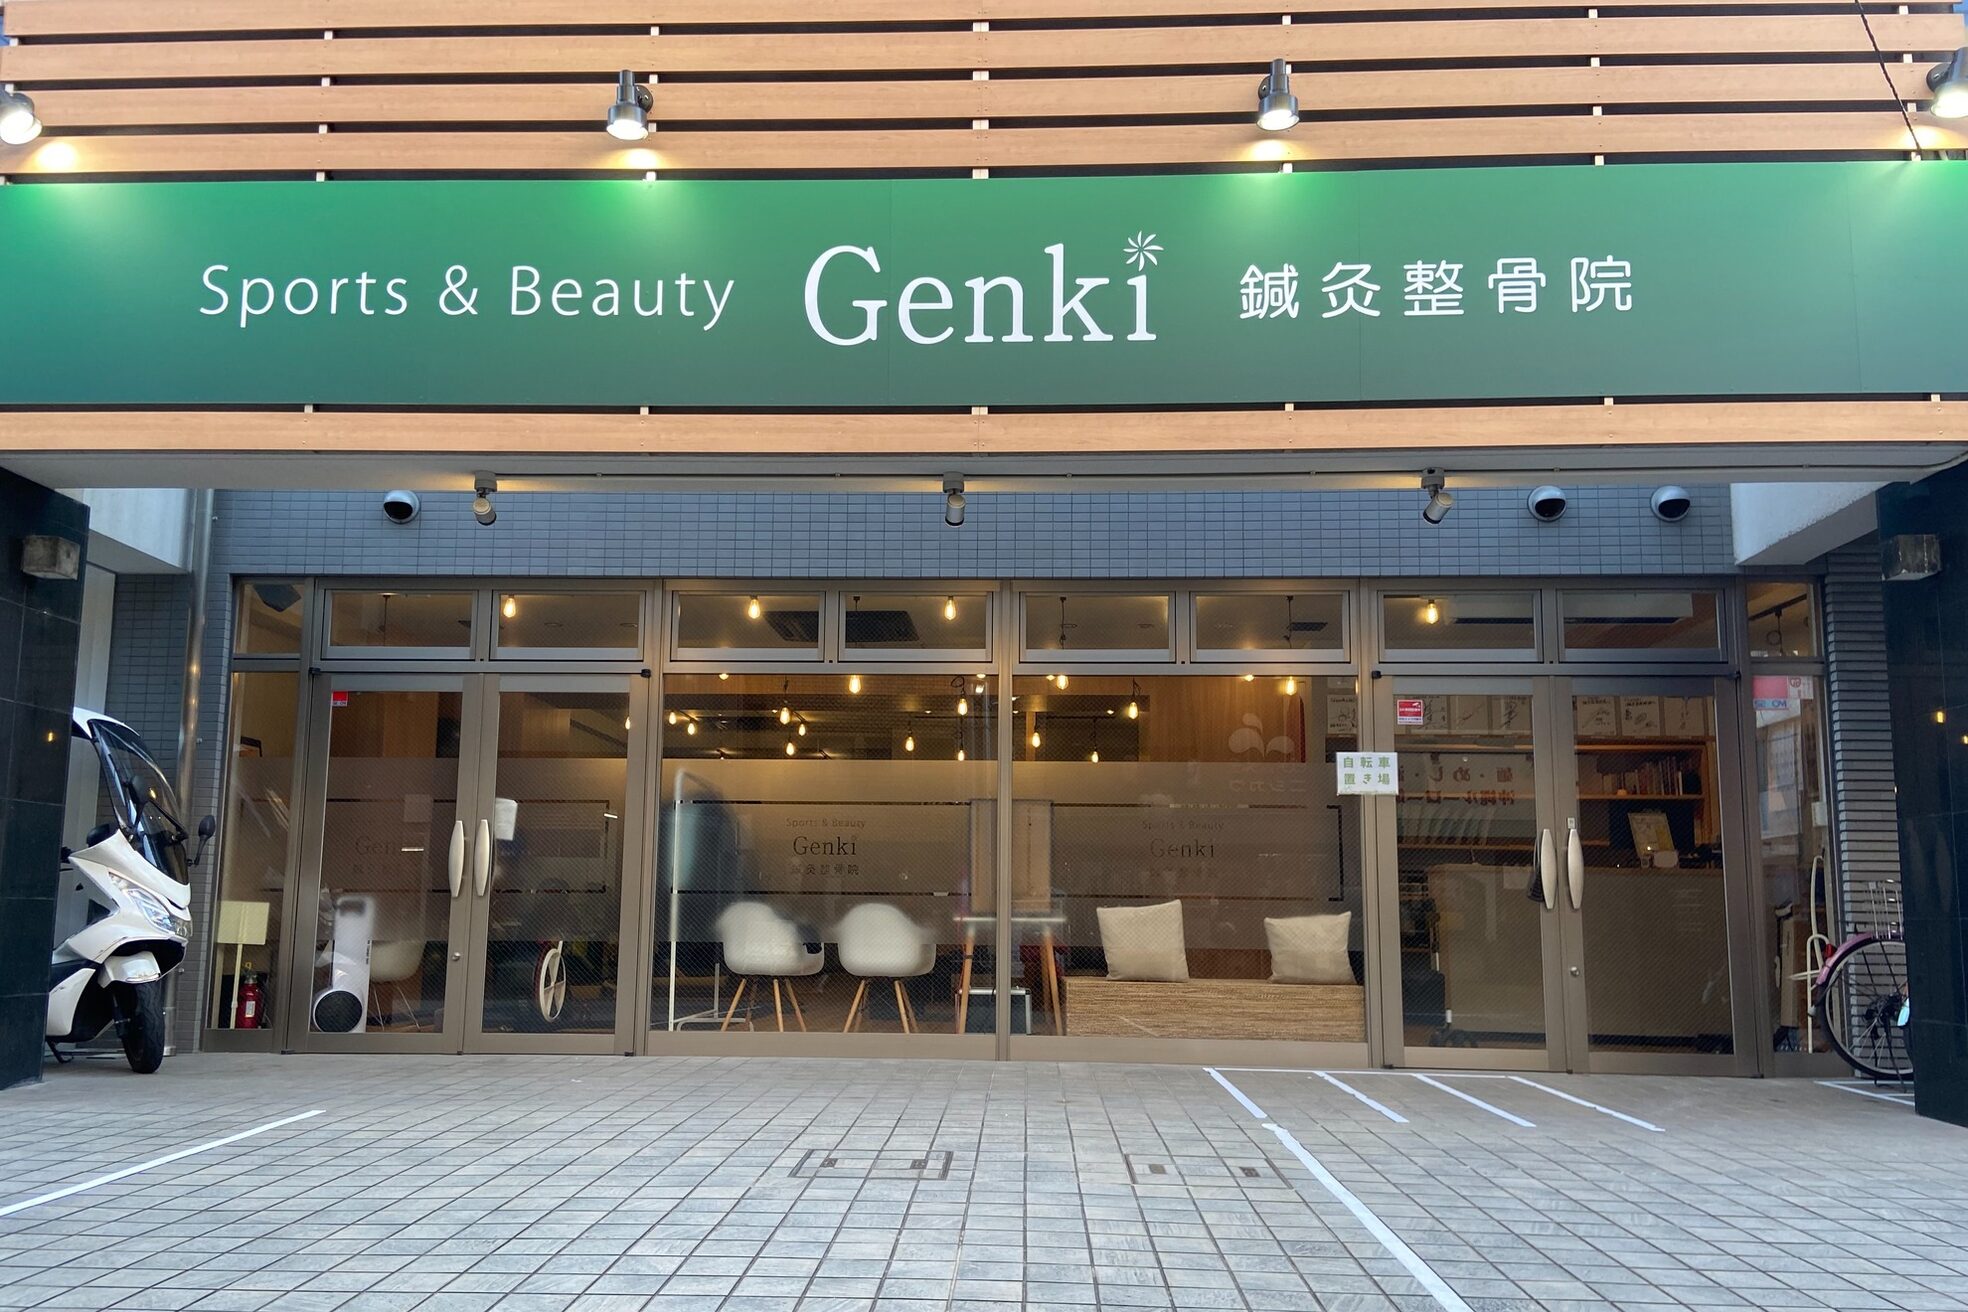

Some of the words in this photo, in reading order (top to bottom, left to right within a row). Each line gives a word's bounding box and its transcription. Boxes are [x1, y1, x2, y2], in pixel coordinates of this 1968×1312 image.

[804, 231, 1164, 346] Genki
[1239, 254, 1633, 319] 鍼灸整骨院
[198, 264, 409, 328] Sports
[438, 264, 479, 316] &
[510, 265, 735, 331] Beauty
[1343, 756, 1391, 769] 自転車
[1344, 773, 1391, 785] 置き場
[793, 835, 857, 856] Genki
[1150, 838, 1214, 857] Genki
